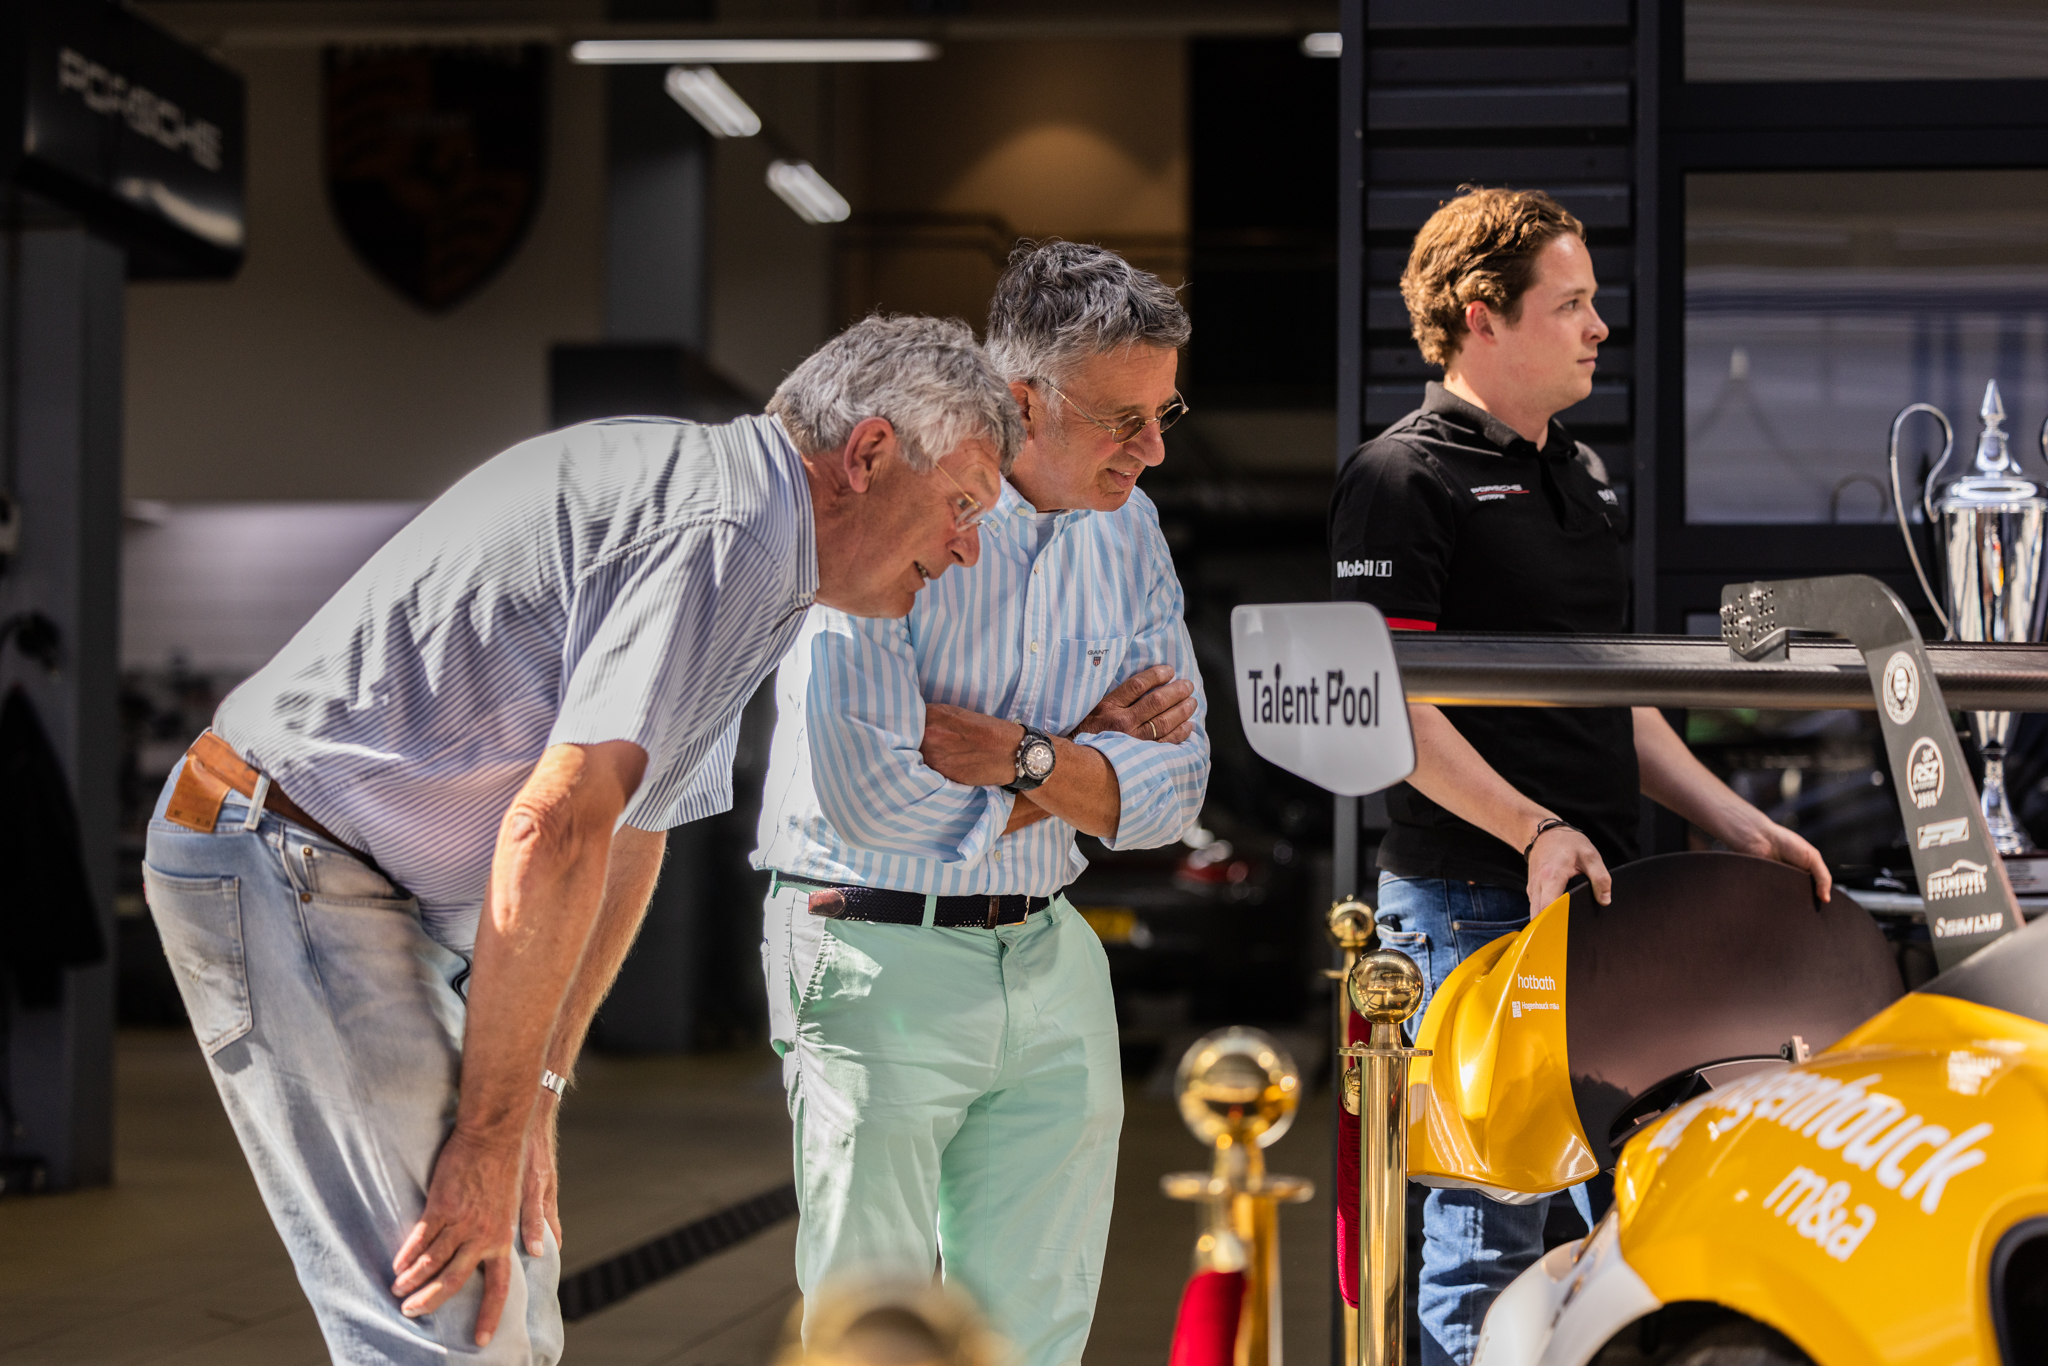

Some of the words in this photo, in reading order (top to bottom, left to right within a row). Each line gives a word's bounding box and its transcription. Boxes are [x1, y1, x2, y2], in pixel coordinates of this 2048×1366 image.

[1337, 559, 1374, 578] Mobil
[1248, 662, 1319, 725] Talent
[1326, 669, 1379, 728] Pool
[1517, 973, 1556, 990] hotbath
[1763, 1164, 1876, 1262] m&a
